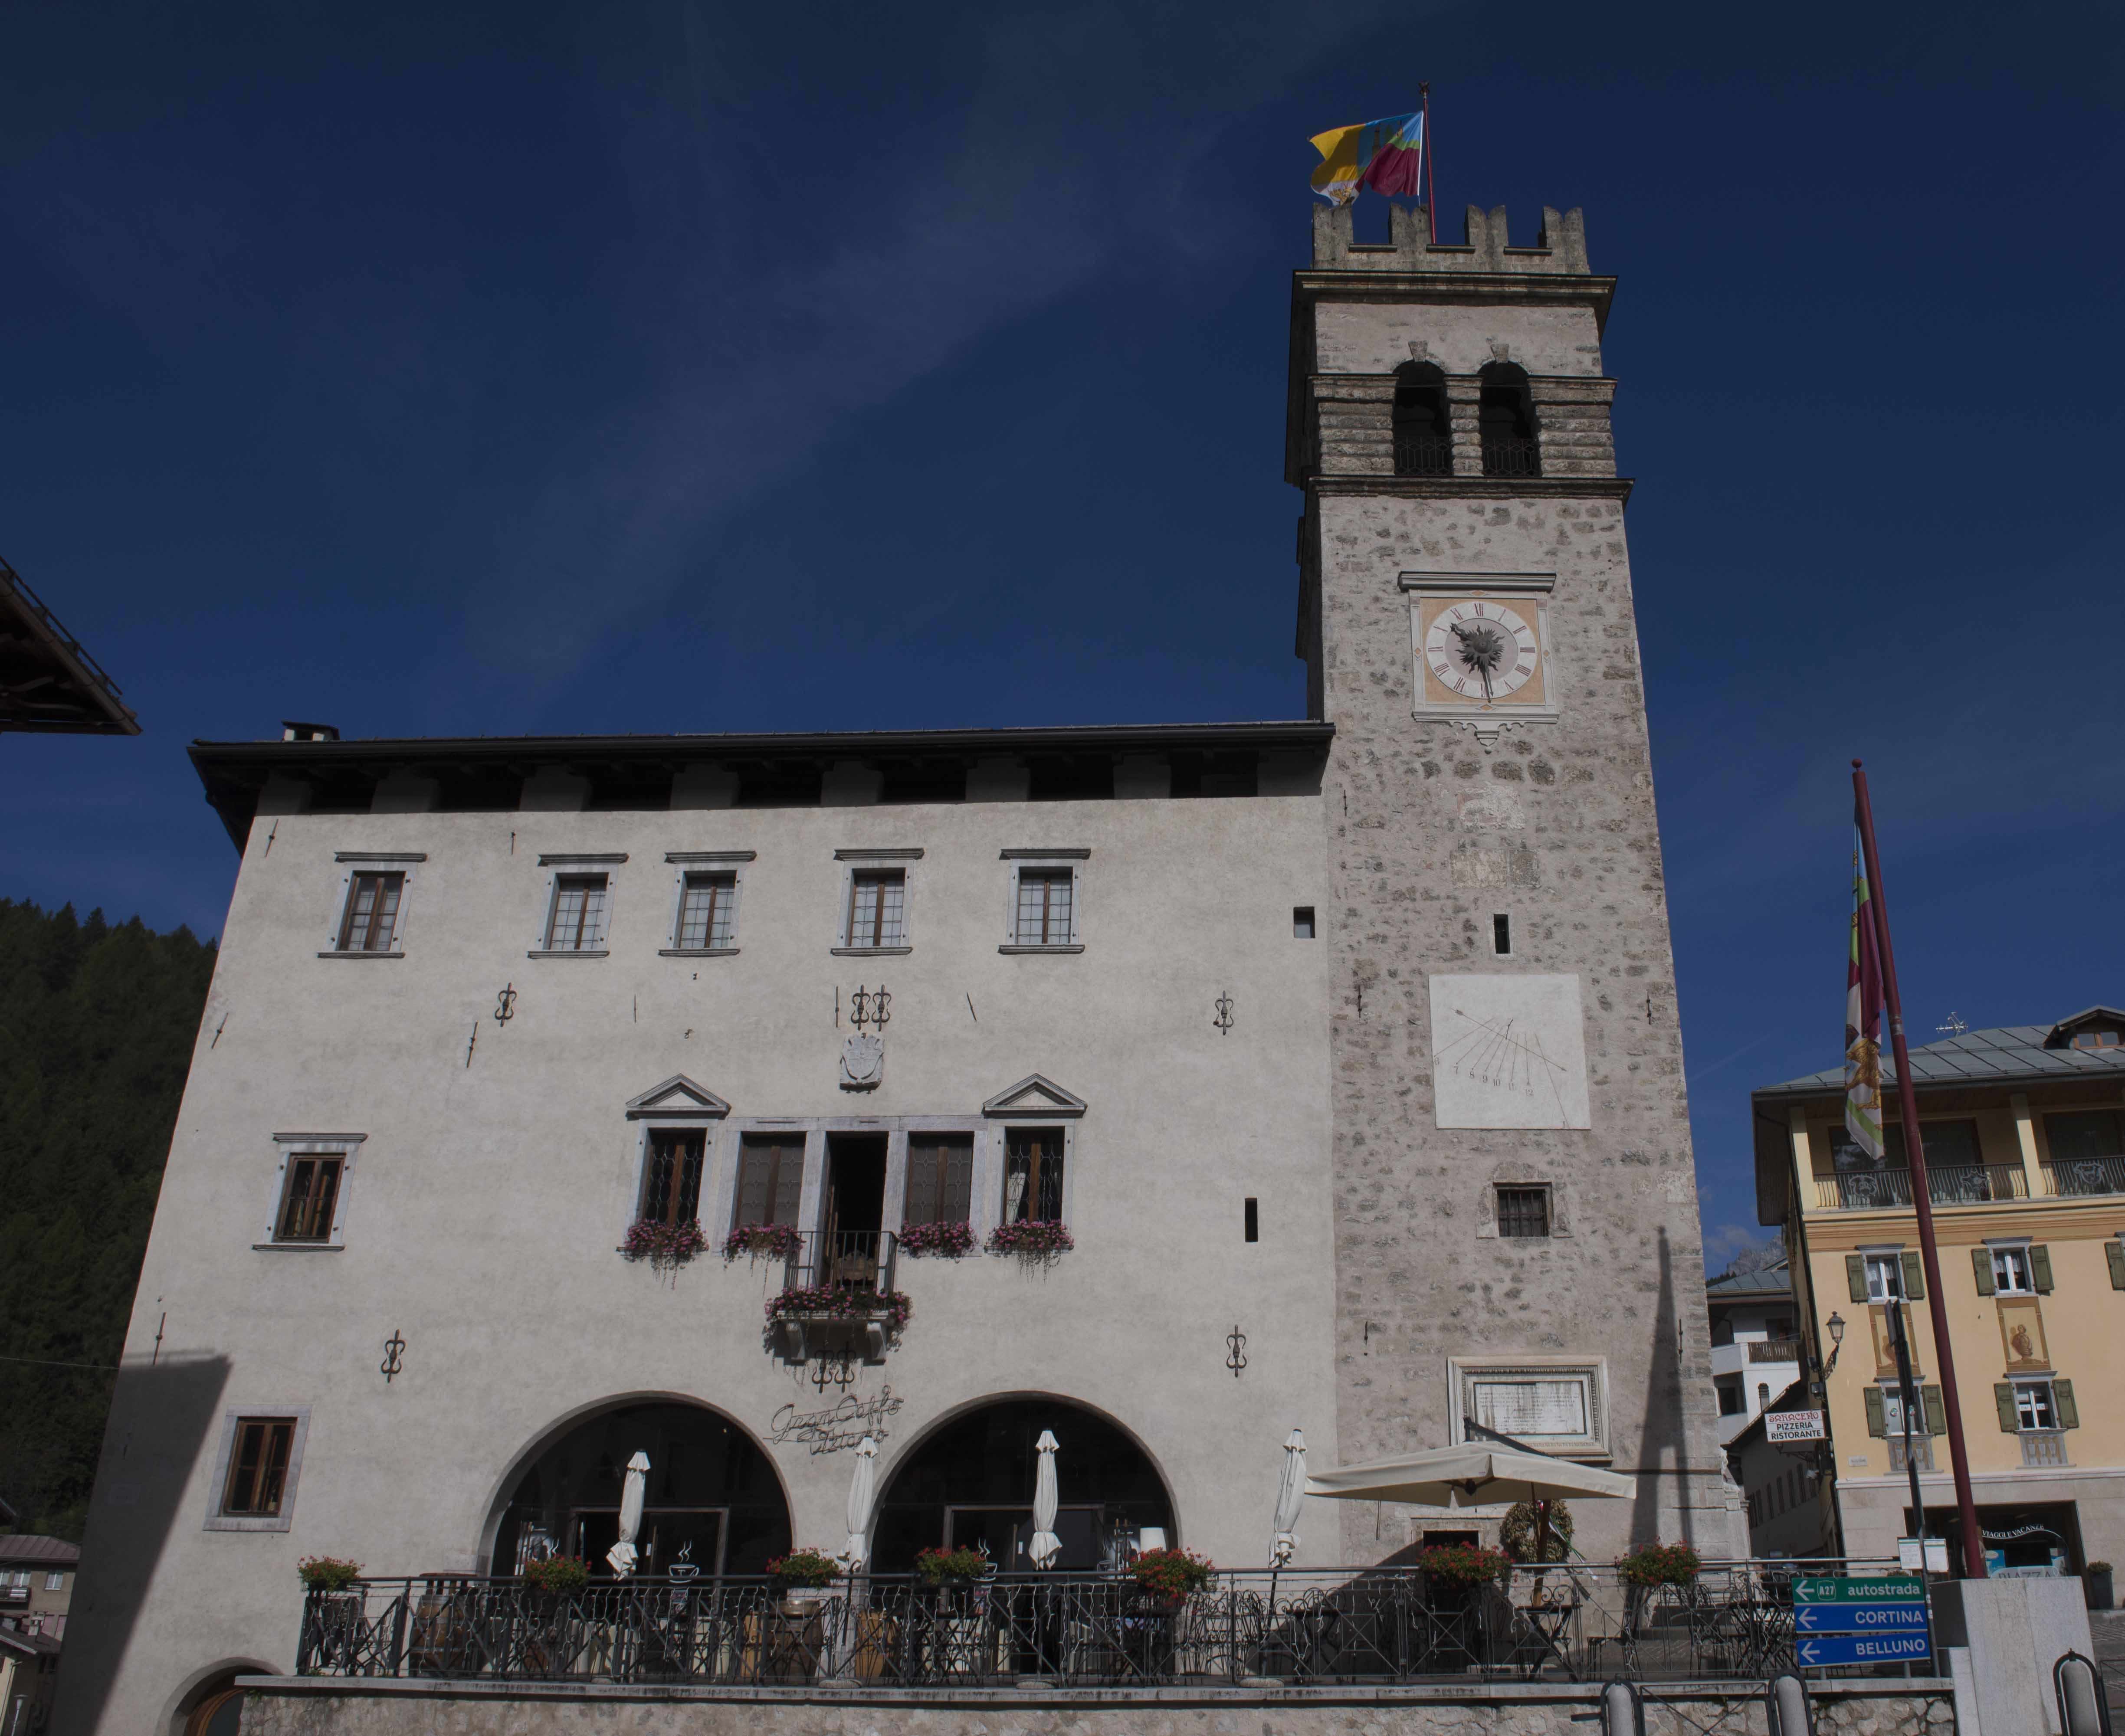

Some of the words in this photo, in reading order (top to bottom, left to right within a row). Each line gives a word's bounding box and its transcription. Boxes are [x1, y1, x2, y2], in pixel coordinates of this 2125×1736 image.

[1474, 603, 1484, 617] XII
[1453, 1065, 1459, 1074] 7
[1482, 1075, 1488, 1083] 9
[1492, 1078, 1501, 1087] 10
[1508, 1082, 1515, 1091] 11
[1525, 1088, 1534, 1096] 12
[1777, 1422, 1813, 1431] PIZZERIA
[1771, 1430, 1821, 1440] RISTORANTE
[1982, 1530, 2006, 1538] VIAGGI
[2012, 1523, 2044, 1536] VACANZE
[1819, 1585, 1834, 1595] A27
[1848, 1583, 1921, 1596] autostrada
[1855, 1610, 1924, 1624] CORTINA
[1856, 1639, 1926, 1656] BELLUNO
